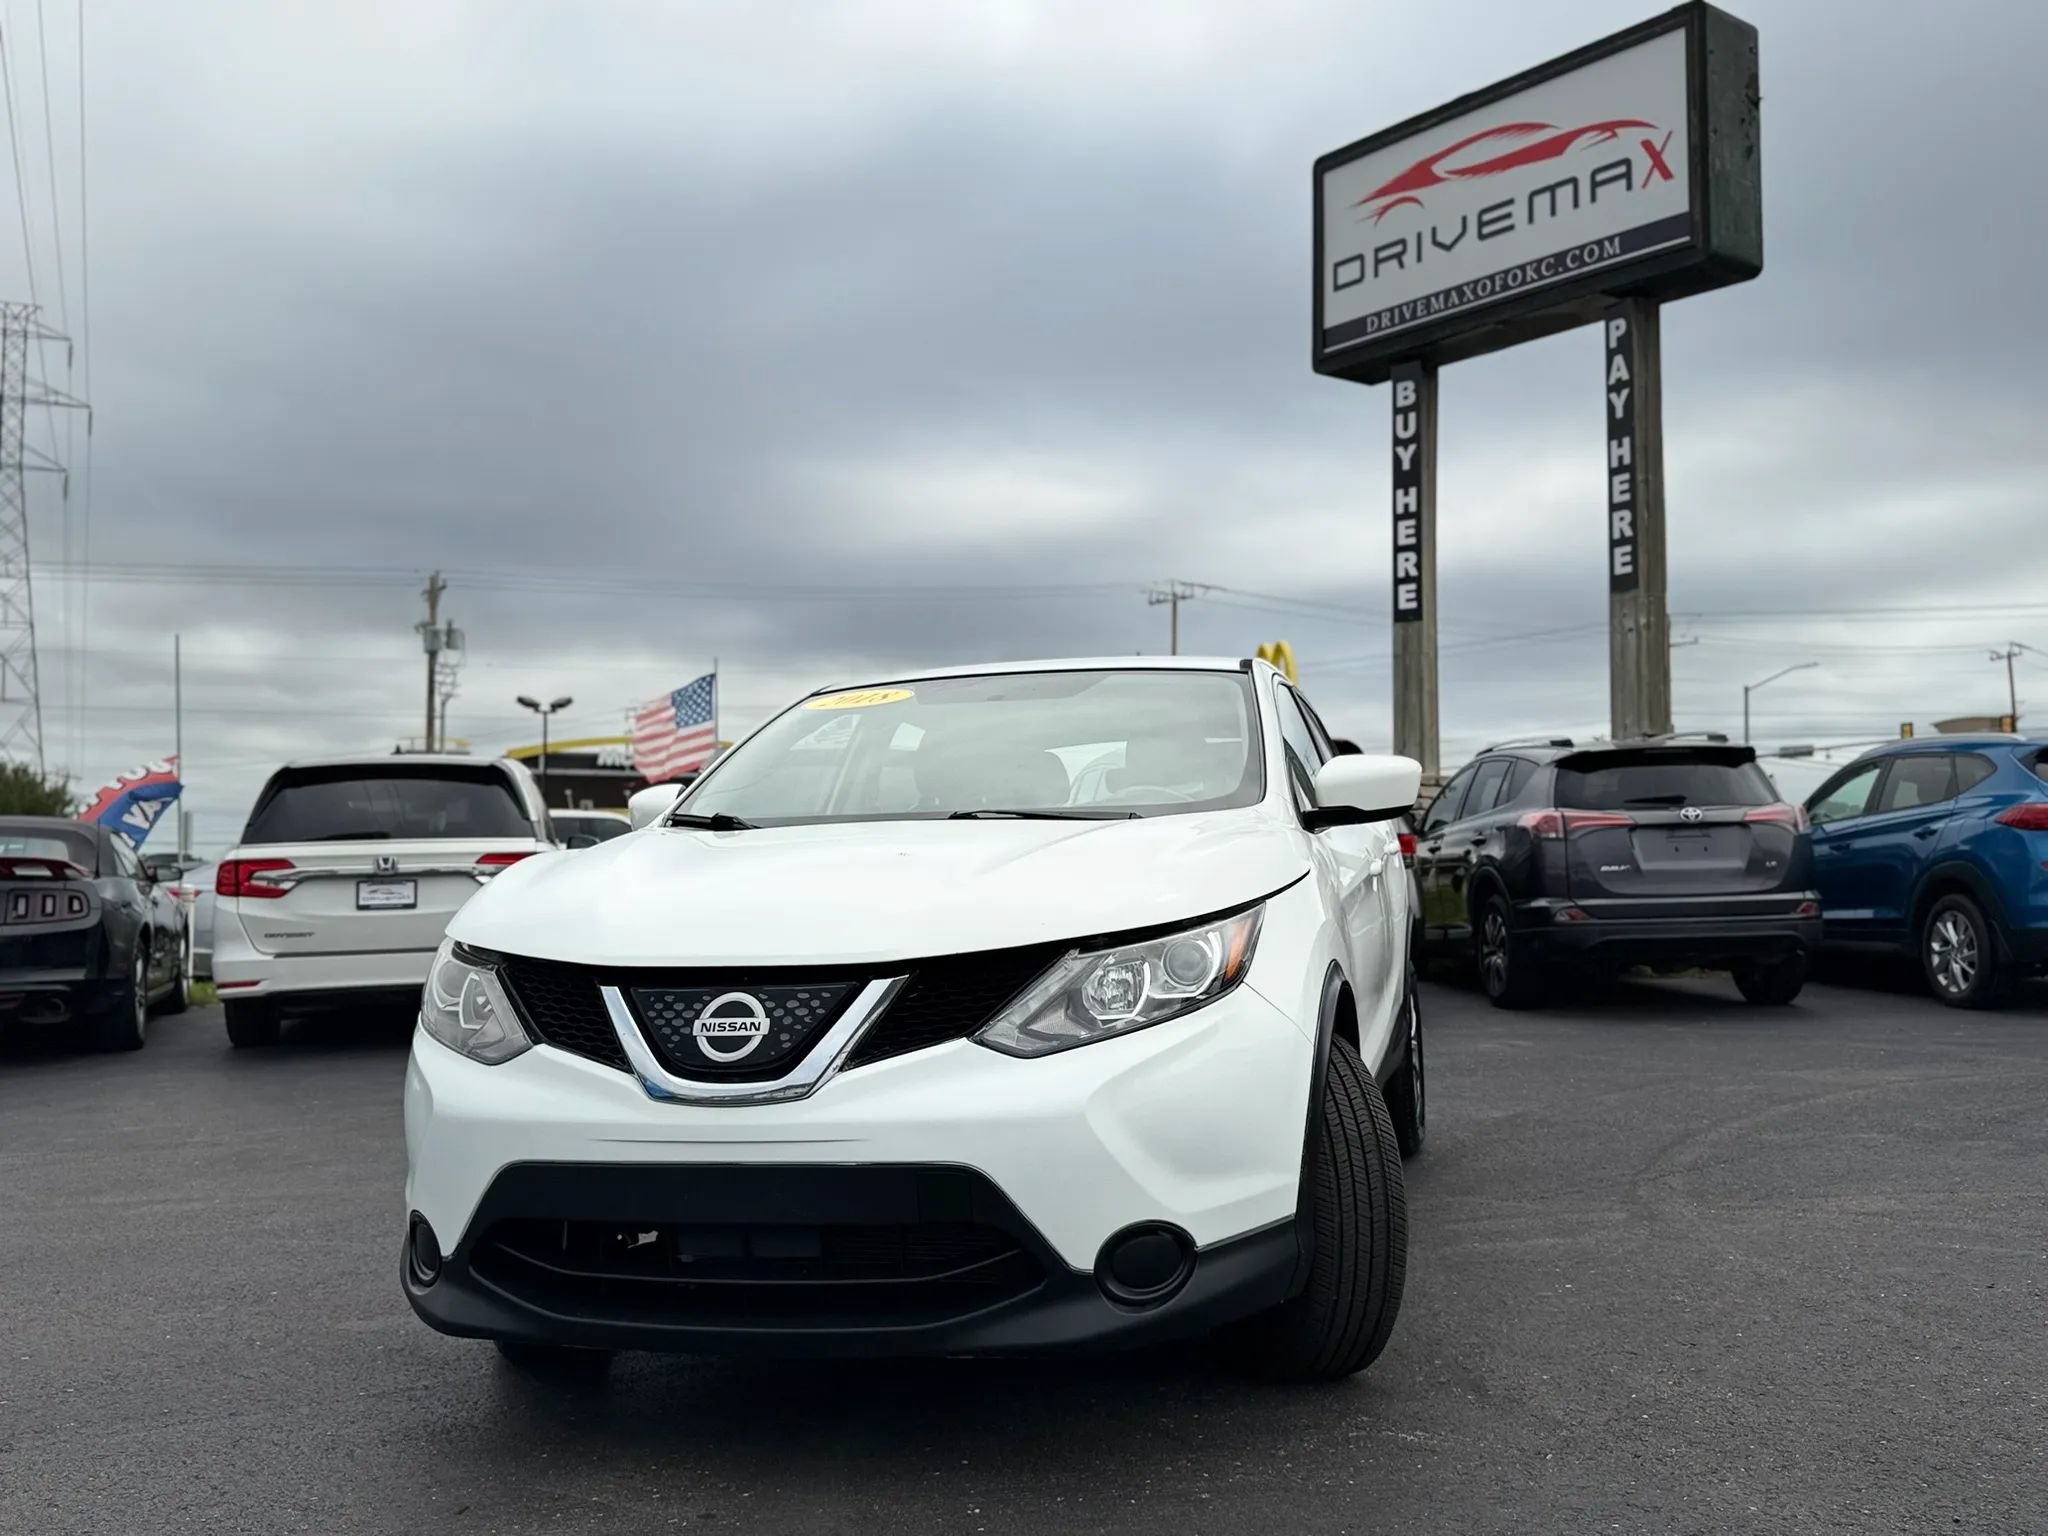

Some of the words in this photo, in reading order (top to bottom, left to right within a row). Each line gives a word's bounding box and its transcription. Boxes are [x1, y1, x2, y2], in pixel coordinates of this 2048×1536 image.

[1332, 130, 1675, 292] DRIVEMAX
[1365, 237, 1622, 334] DRIVEMAXOFOKC.COM
[1608, 318, 1630, 420] PAY
[1395, 380, 1417, 471] BUY
[1395, 486, 1419, 610] HERE
[1609, 436, 1633, 576] HERE
[700, 1021, 761, 1033] NISSAN
